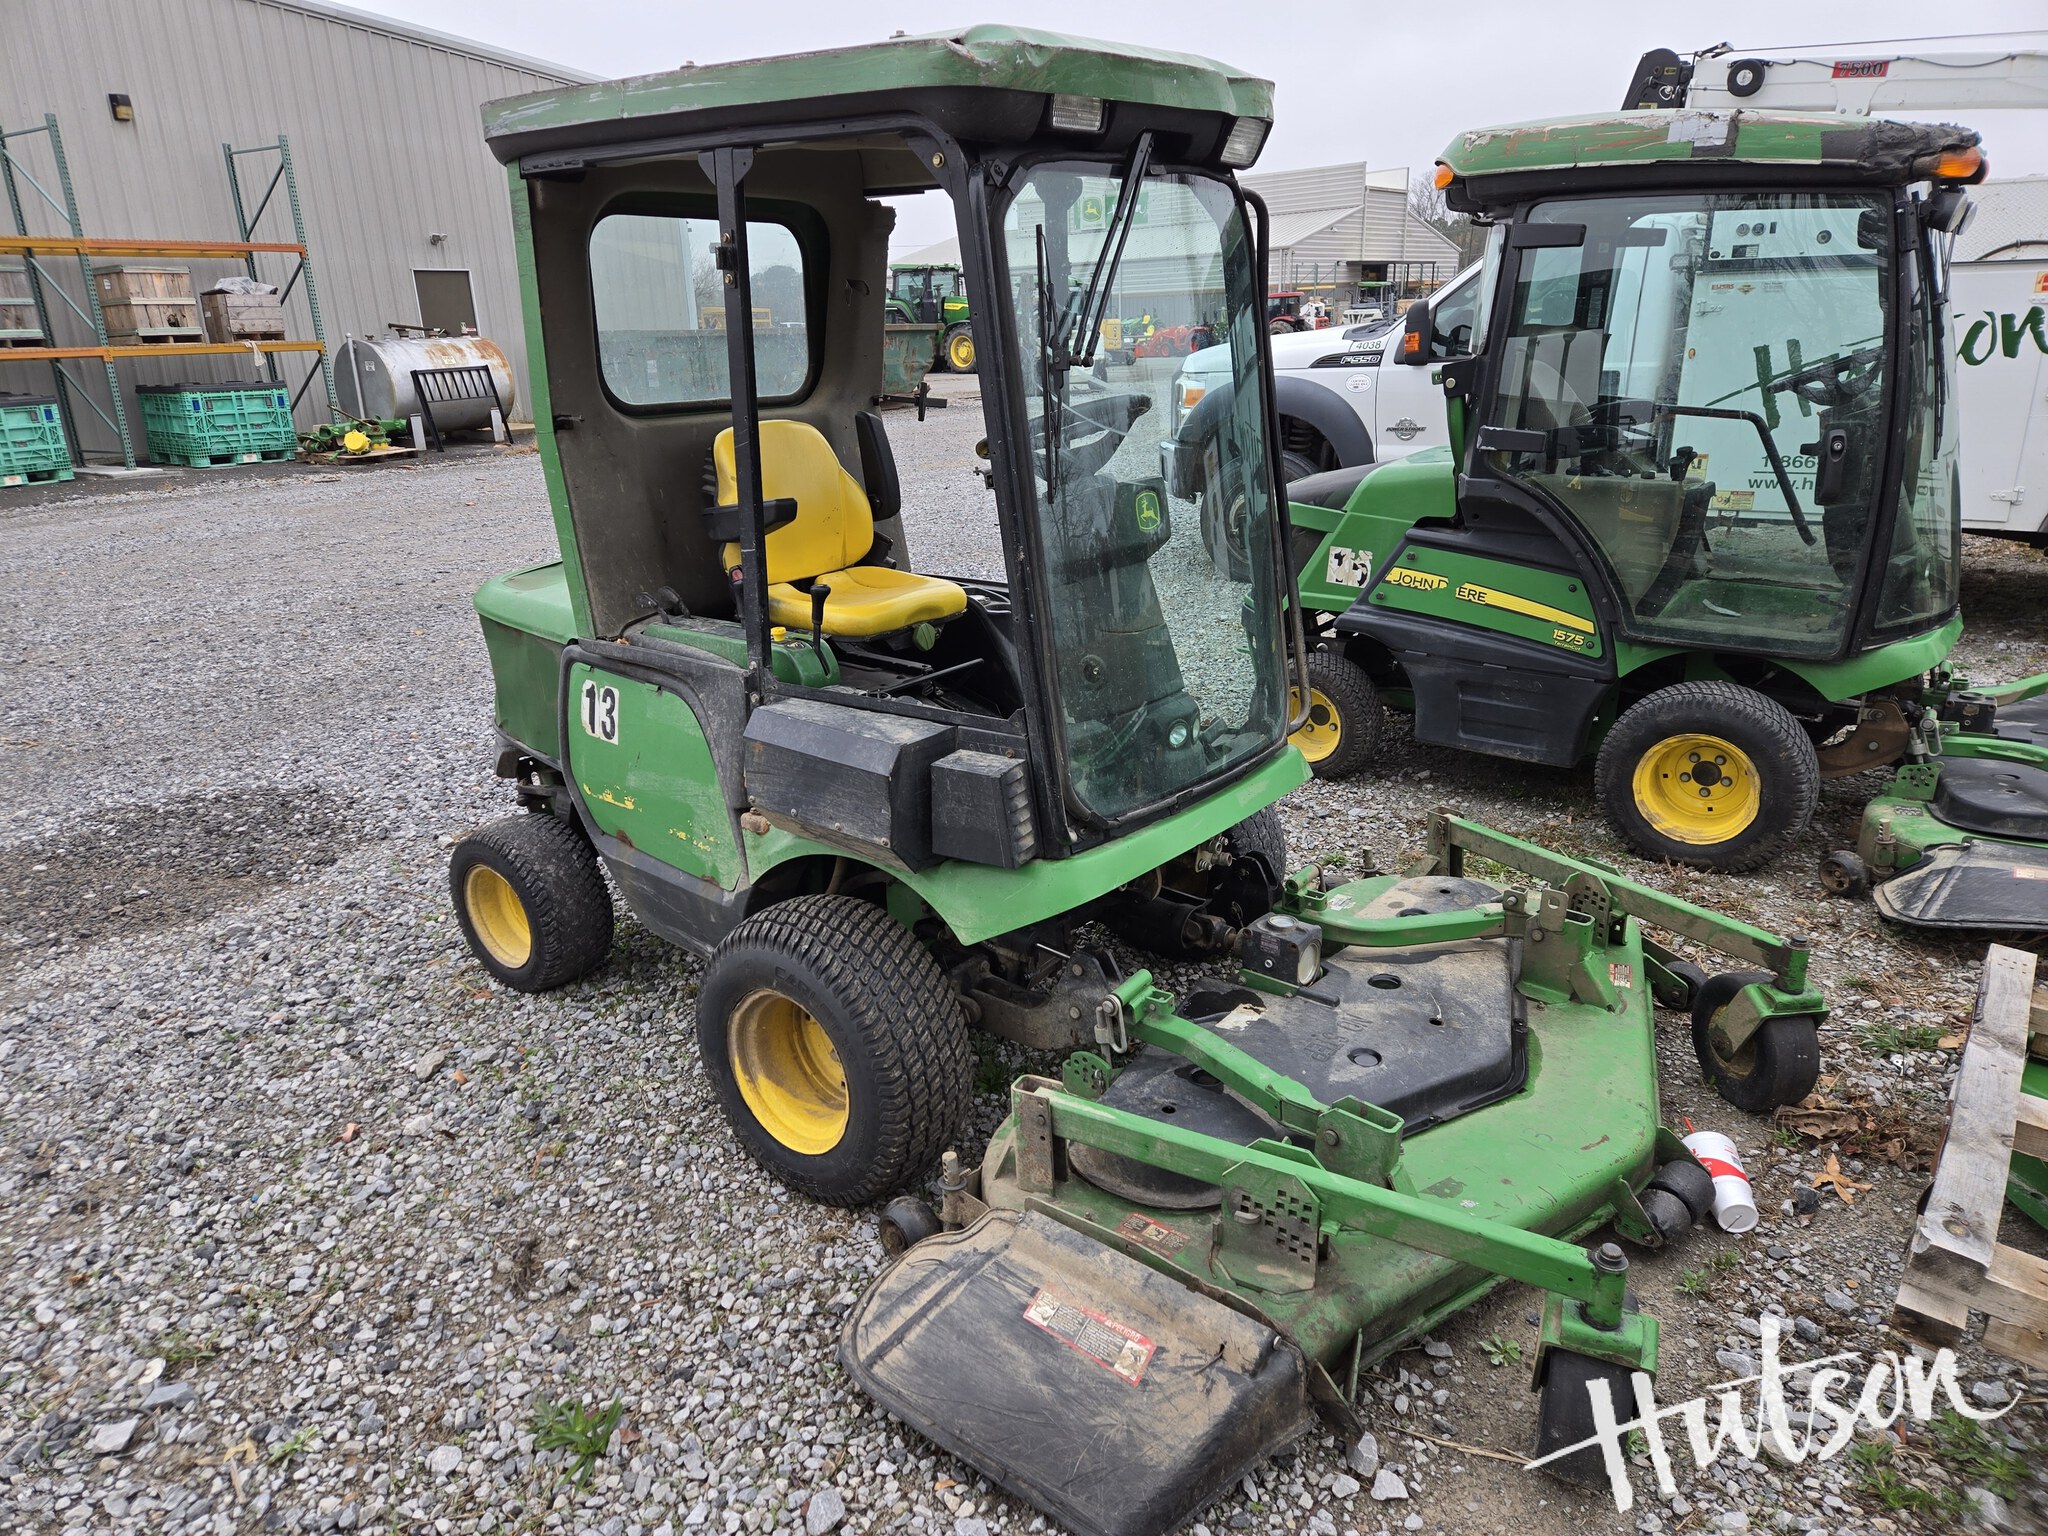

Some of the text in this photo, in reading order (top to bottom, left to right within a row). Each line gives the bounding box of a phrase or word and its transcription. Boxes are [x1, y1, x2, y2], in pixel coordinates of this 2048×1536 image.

[1839, 62, 1884, 77] 7500
[1356, 341, 1381, 350] 4038
[1762, 455, 1818, 468] 1866
[1748, 477, 1814, 490] ww.h
[1393, 572, 1487, 603] JOHN DERE
[1552, 629, 1584, 646] 1575
[585, 683, 616, 740] 13
[1112, 1321, 1142, 1343] PELIGRO
